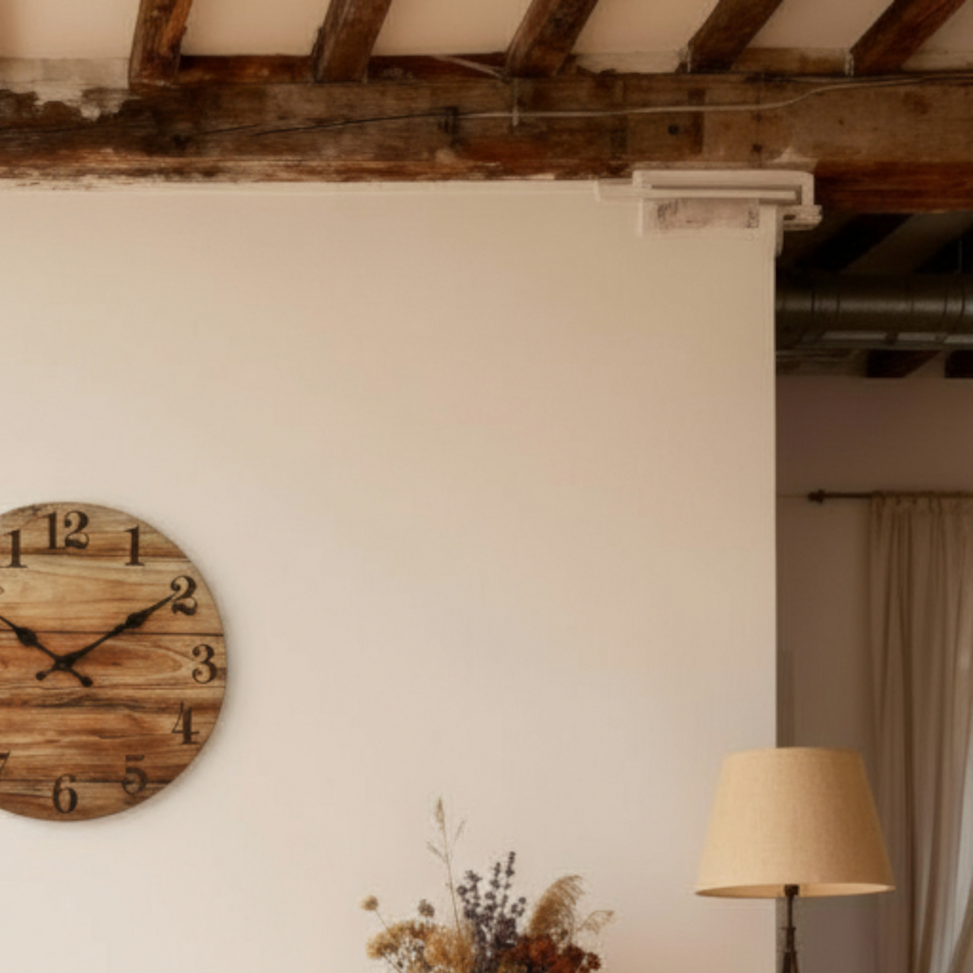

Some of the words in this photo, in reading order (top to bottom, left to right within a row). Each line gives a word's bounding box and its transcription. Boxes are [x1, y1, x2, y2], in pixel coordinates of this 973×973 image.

[44, 510, 89, 550] 12
[124, 525, 145, 566] 1
[170, 575, 198, 616] 2
[192, 644, 217, 684] 3
[171, 702, 199, 745] 4
[53, 774, 77, 814] 6
[122, 754, 147, 795] 5
